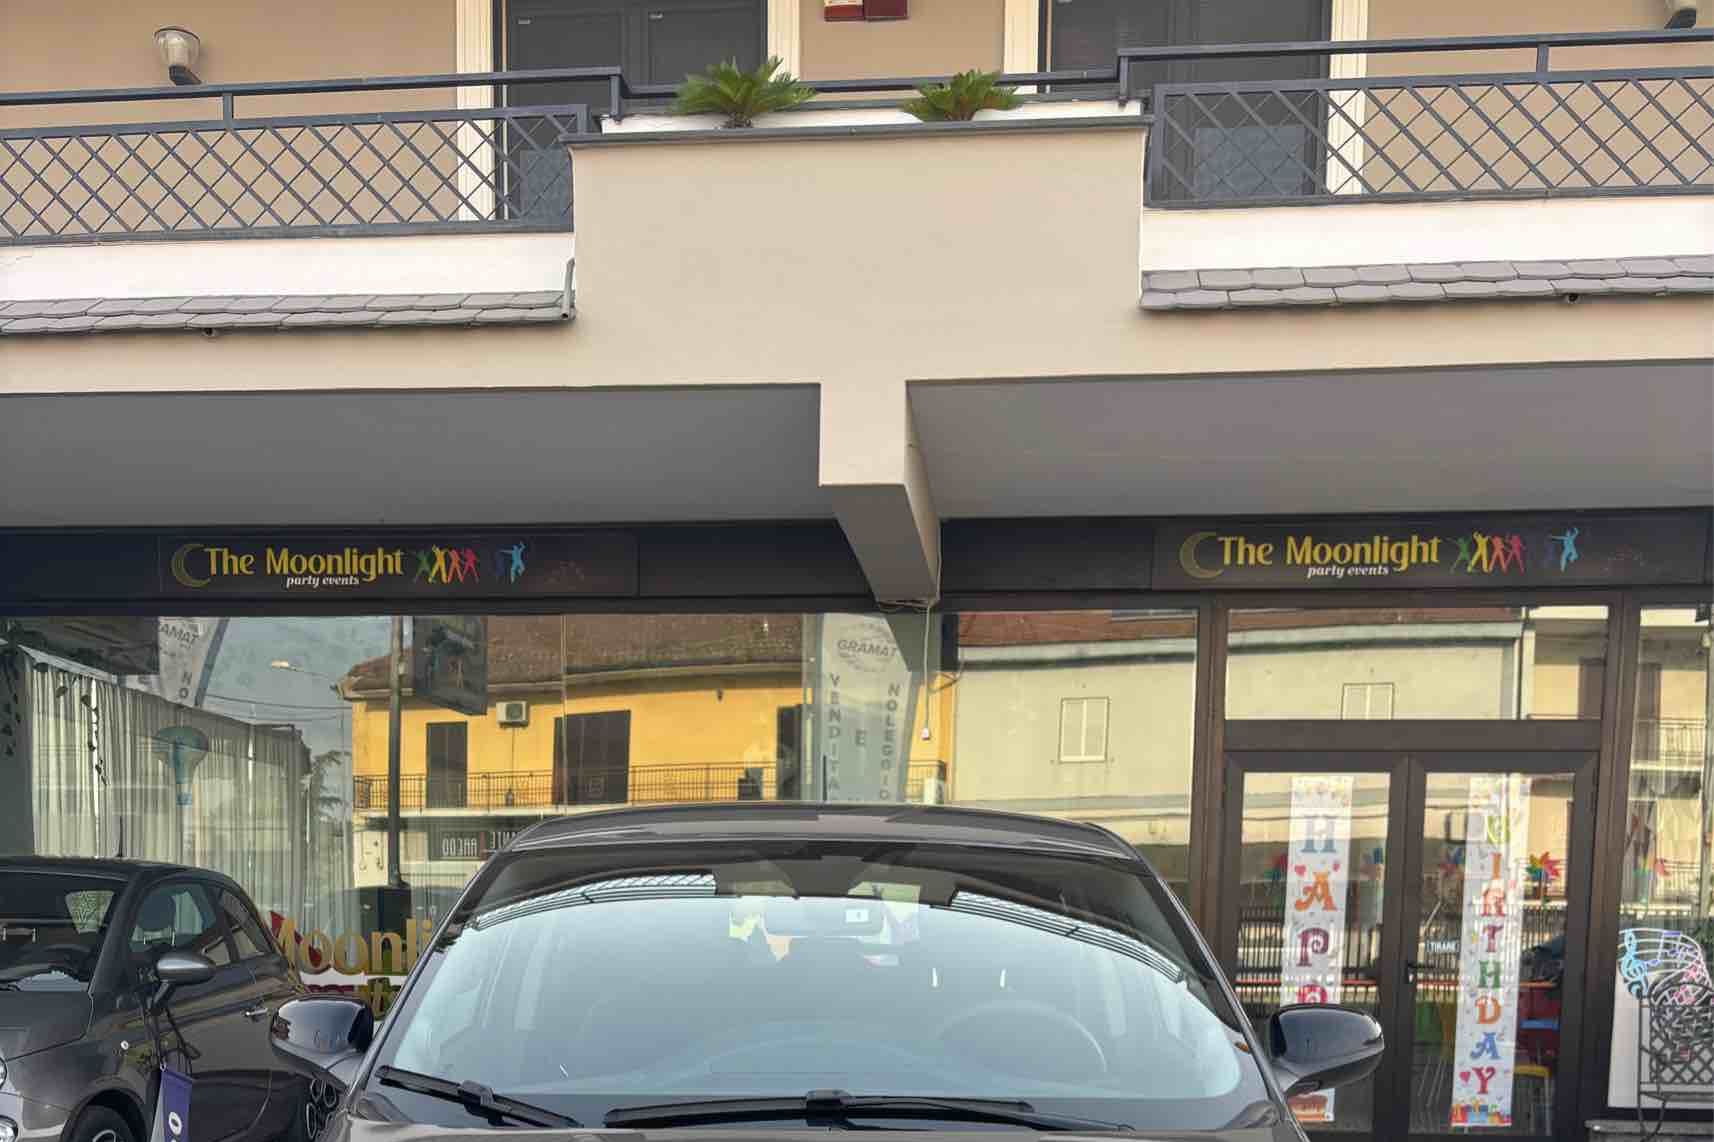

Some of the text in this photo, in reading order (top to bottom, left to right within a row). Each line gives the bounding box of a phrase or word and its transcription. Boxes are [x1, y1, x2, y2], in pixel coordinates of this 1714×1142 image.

[204, 546, 406, 582] The Moonlight
[1217, 534, 1441, 572] The Moonlight
[285, 575, 360, 589] party events
[1306, 565, 1390, 580] party events
[160, 623, 200, 645] AMAT
[1294, 815, 1338, 1005] HAPP
